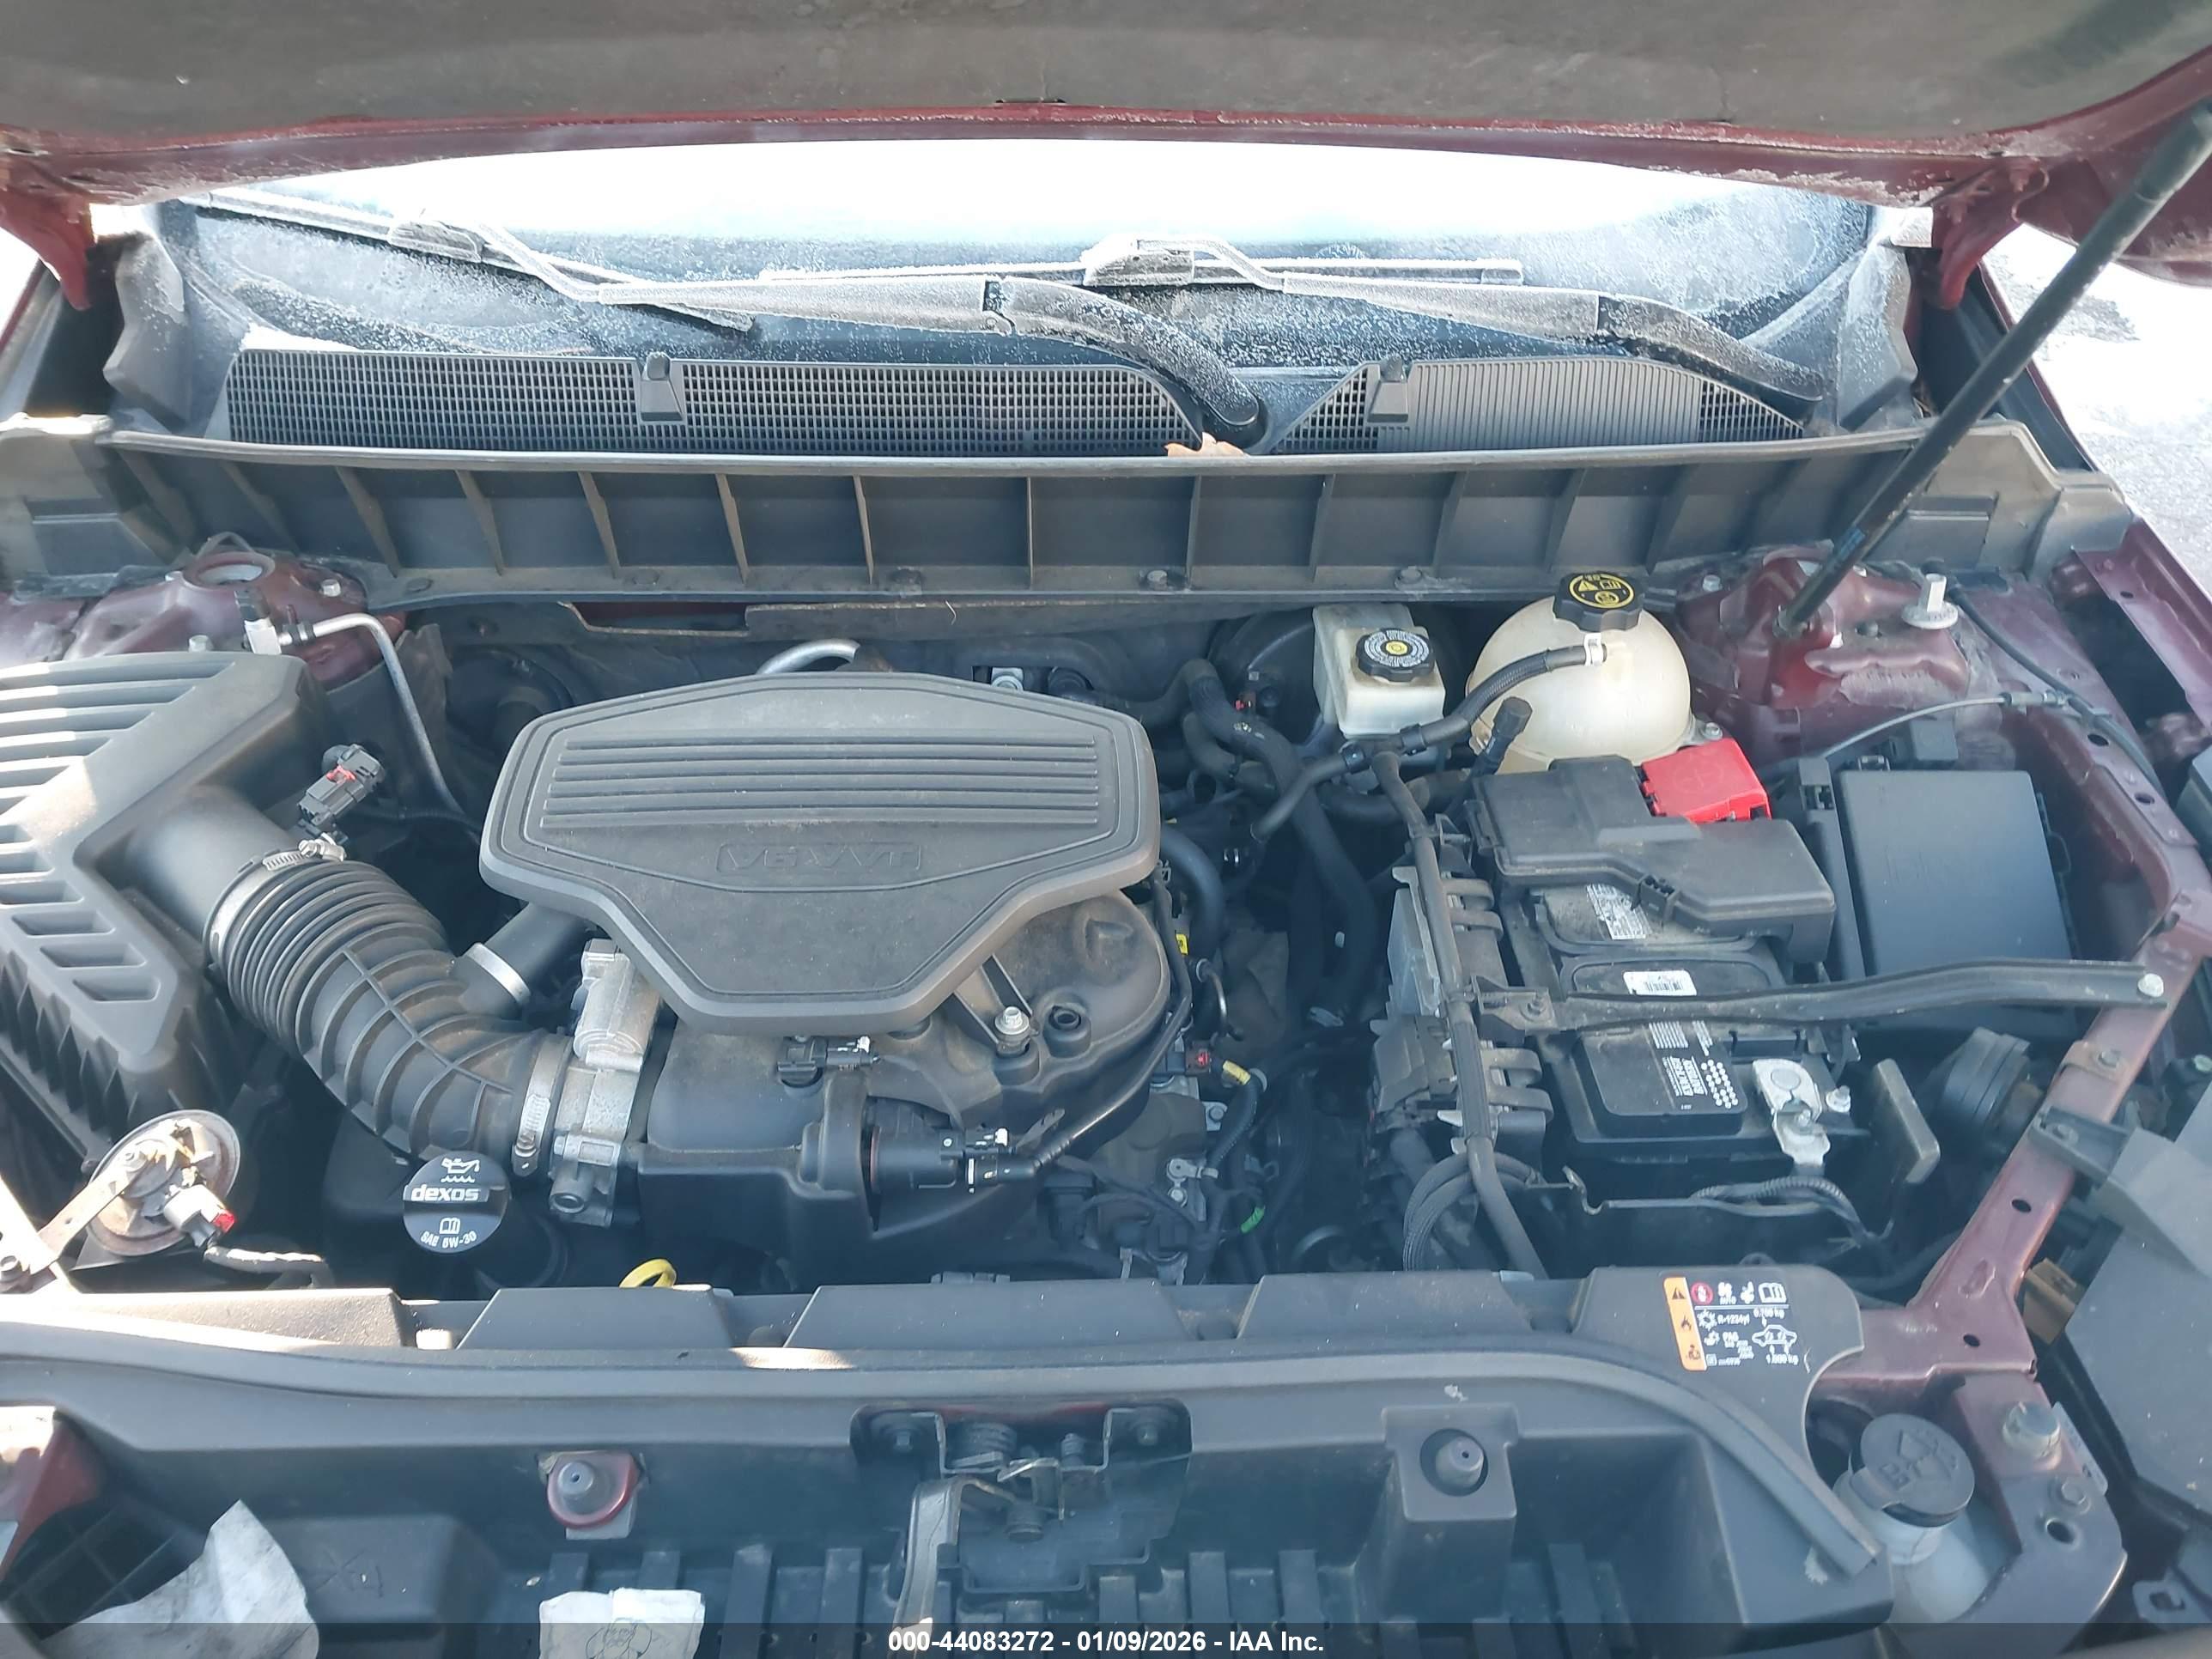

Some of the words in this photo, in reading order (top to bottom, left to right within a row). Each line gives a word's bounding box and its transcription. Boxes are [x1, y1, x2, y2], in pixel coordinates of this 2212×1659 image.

[726, 847, 798, 868] V6
[809, 847, 913, 868] VVT
[411, 1184, 479, 1201] dexos
[420, 1231, 440, 1247] SAE
